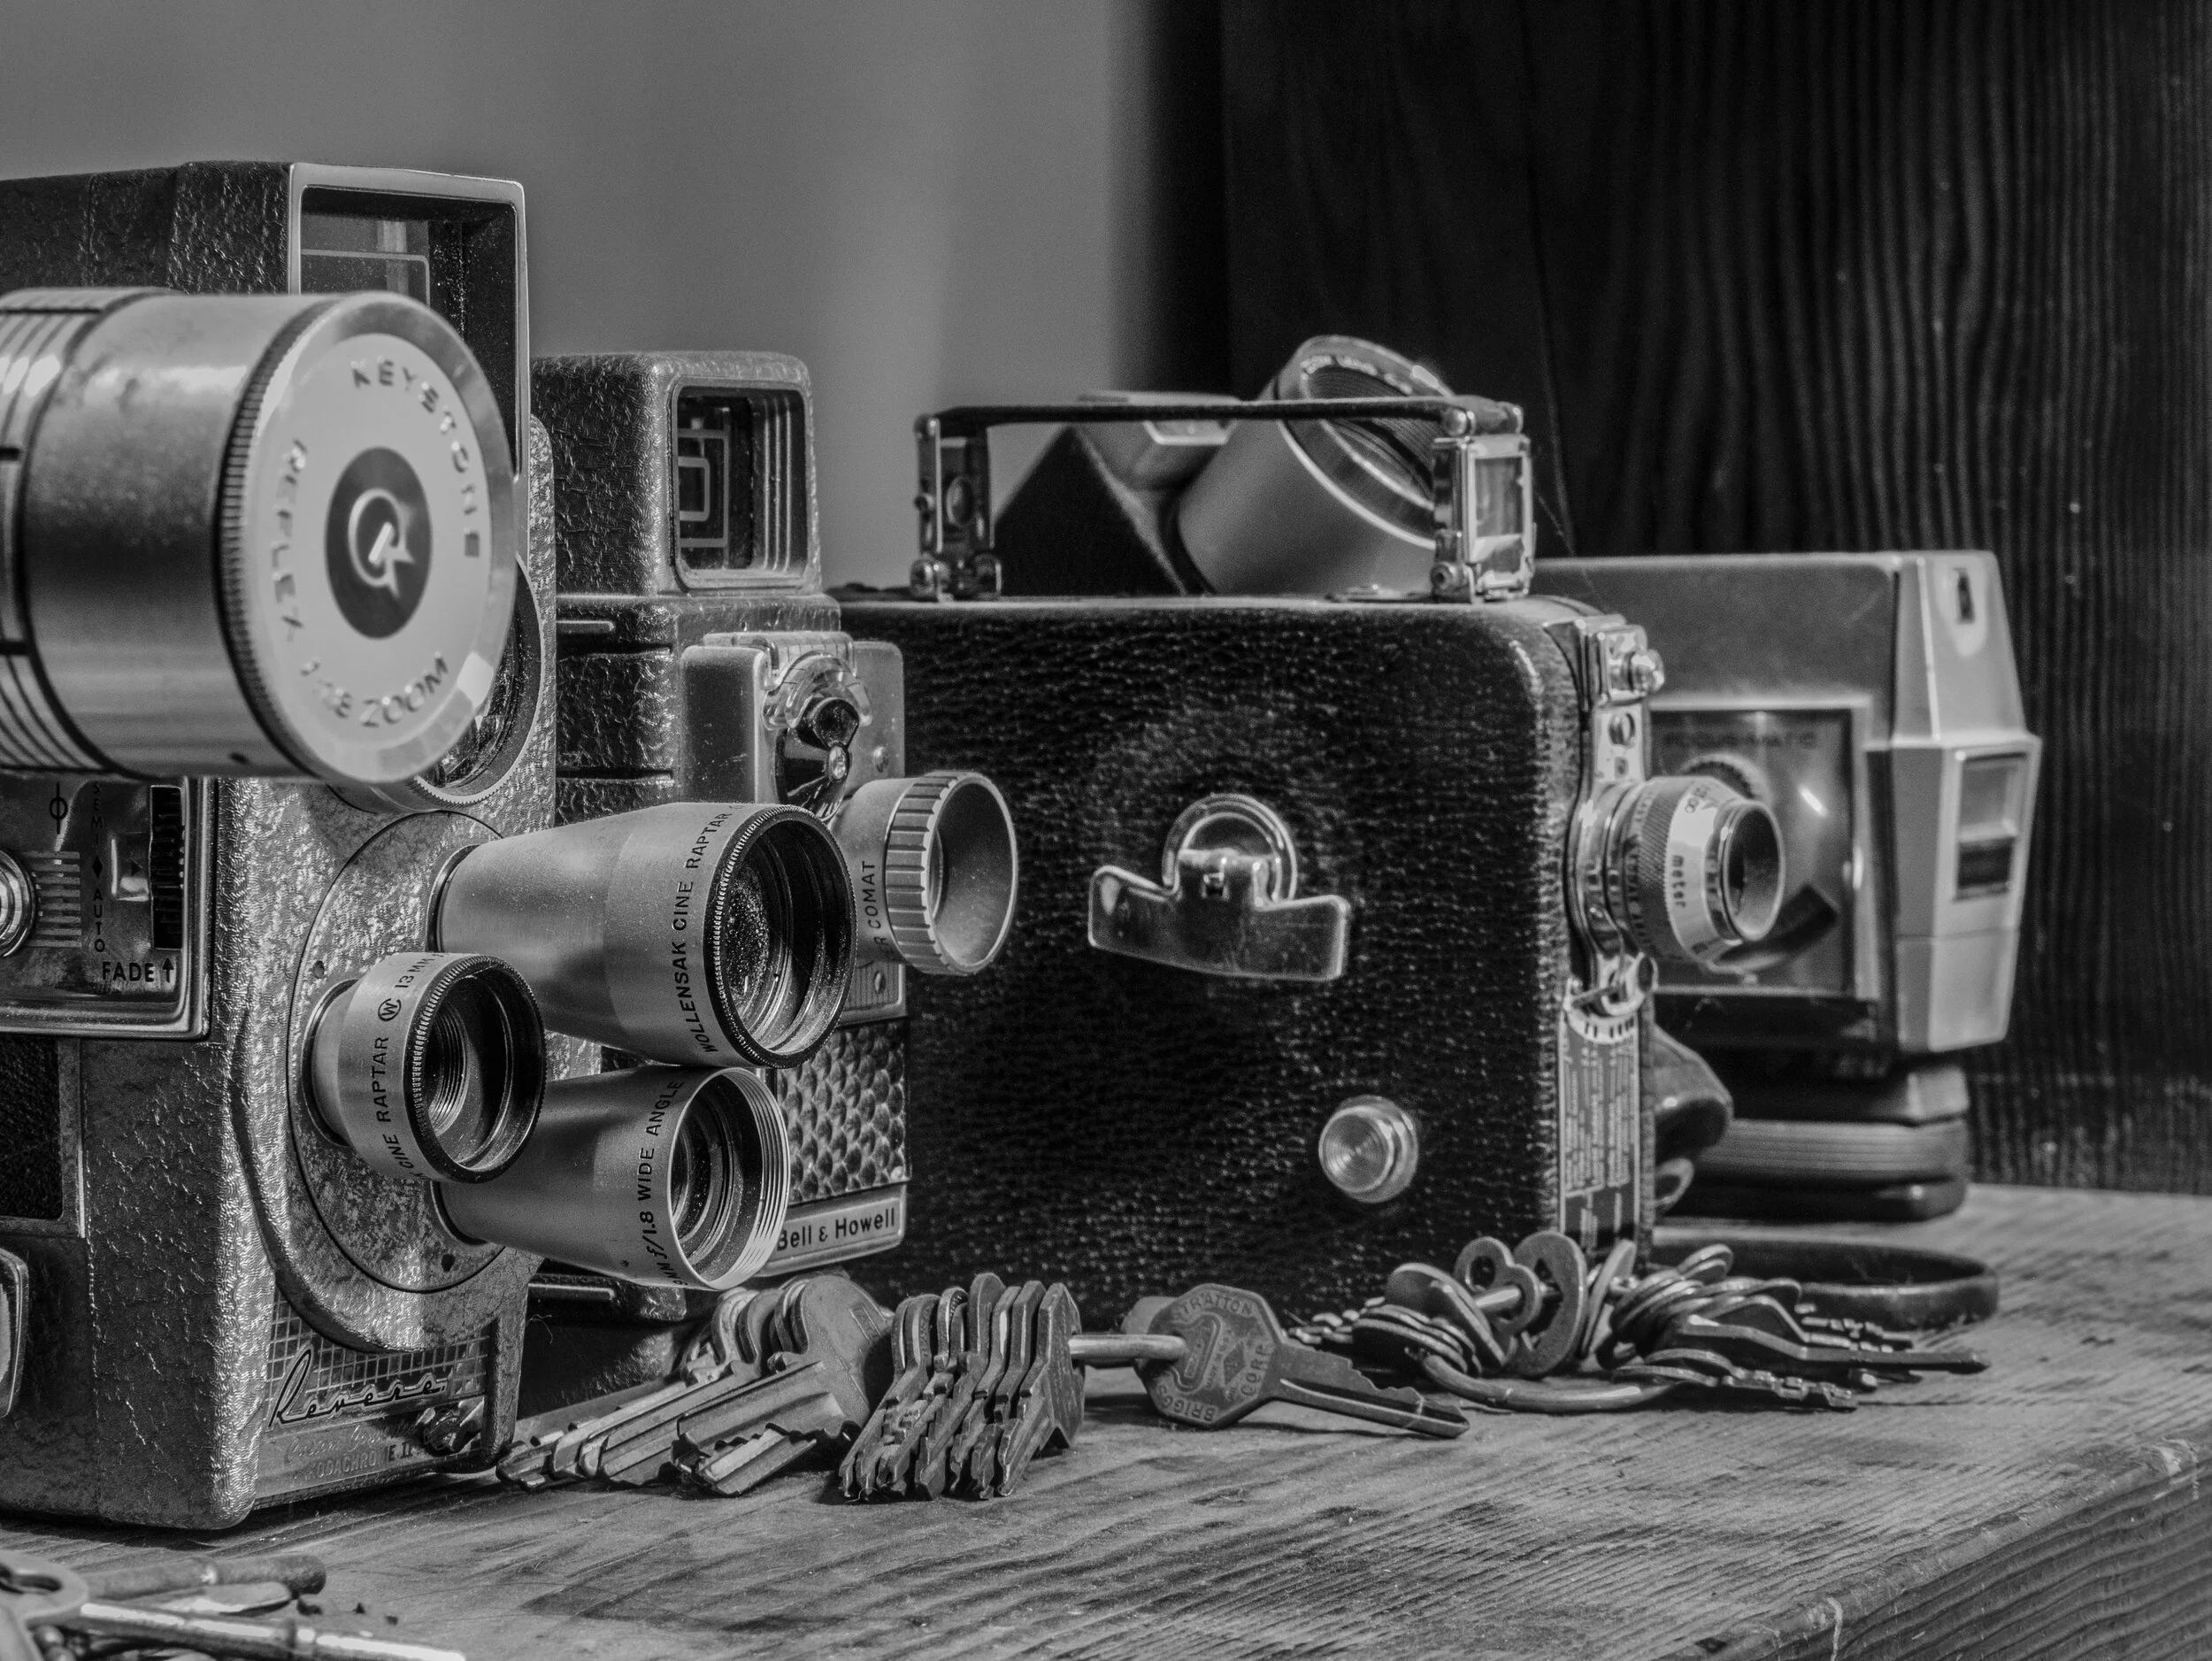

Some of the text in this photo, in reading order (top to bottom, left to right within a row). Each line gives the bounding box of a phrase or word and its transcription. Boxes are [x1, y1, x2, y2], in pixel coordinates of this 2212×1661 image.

[861, 860, 882, 929] COMAT
[1671, 854, 1686, 909] meter
[92, 888, 105, 953] AUTO
[672, 812, 733, 1053] WOLLENSAK CINE RAPTAR
[102, 961, 155, 982] FADE
[371, 1036, 391, 1123] RAPTAR
[382, 1134, 415, 1169] CINE
[637, 1147, 655, 1202] WIDE
[646, 1080, 685, 1136] ANGLE
[777, 1207, 895, 1252] Bell & Howell
[267, 1346, 449, 1428] Revere
